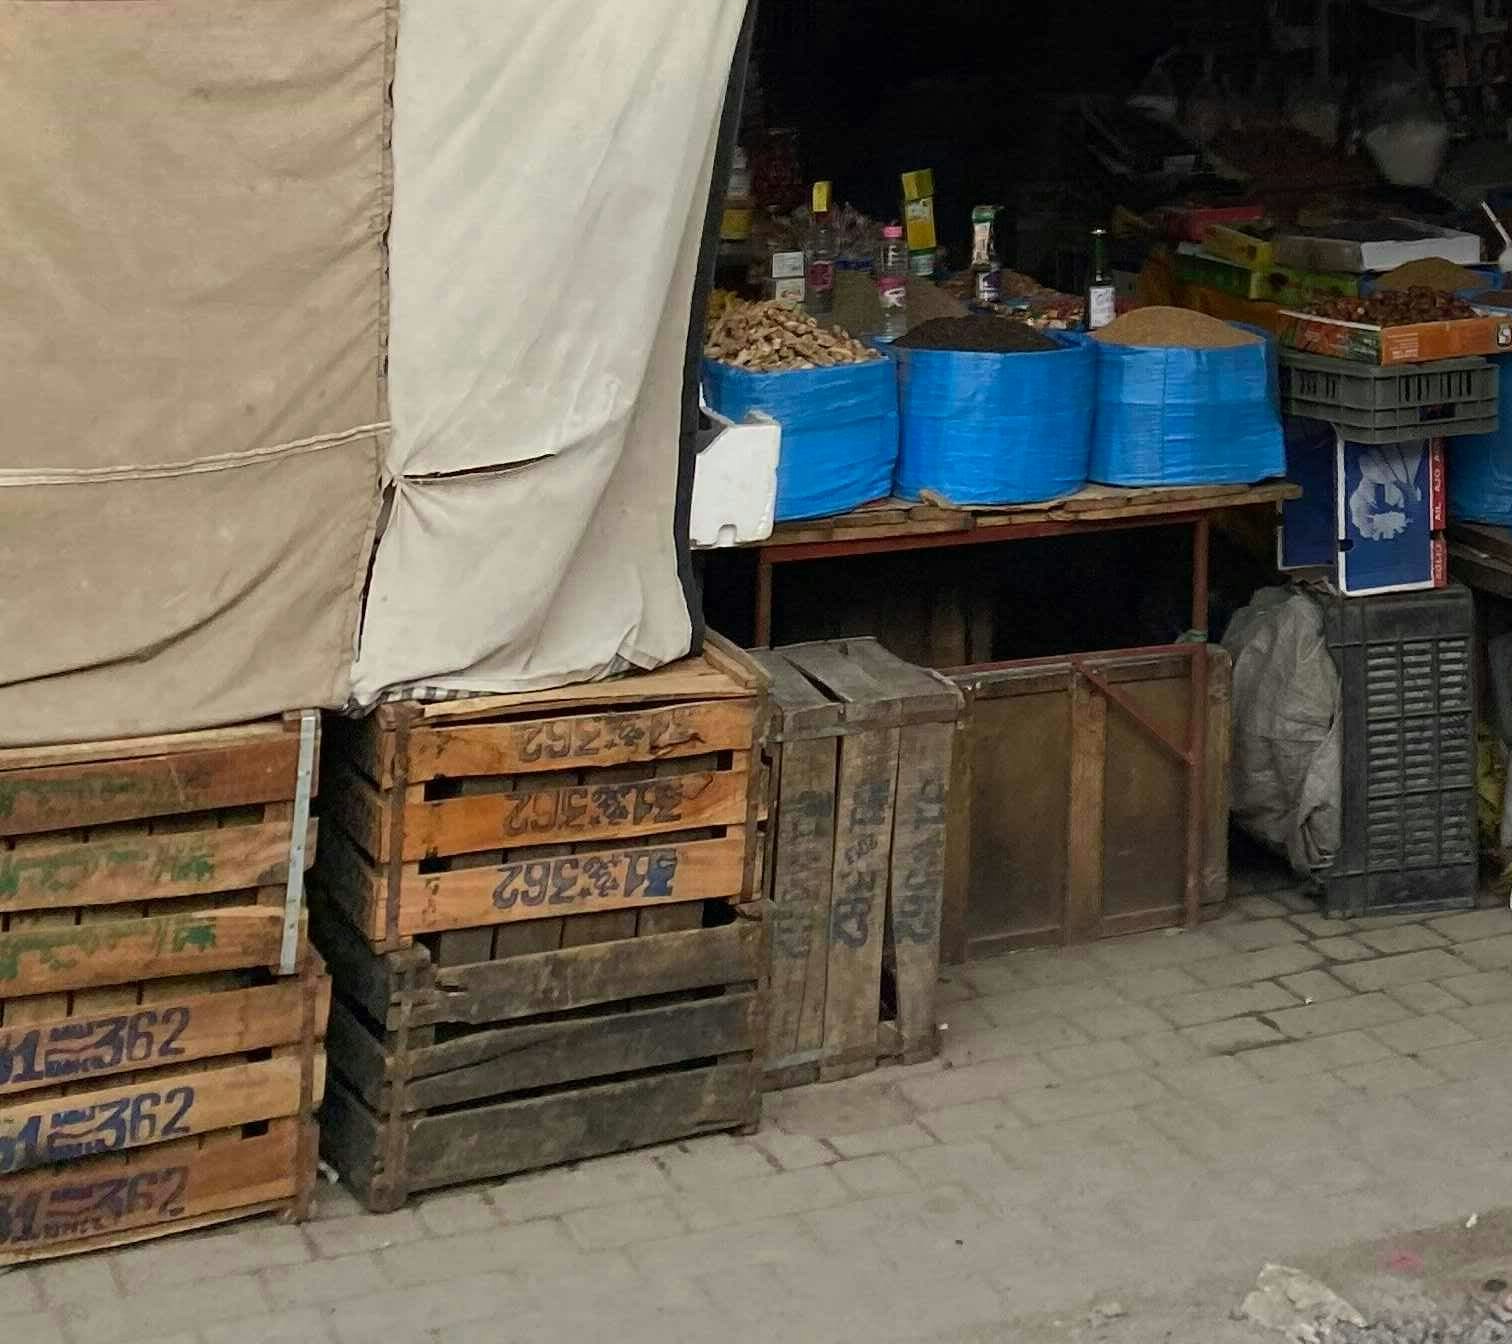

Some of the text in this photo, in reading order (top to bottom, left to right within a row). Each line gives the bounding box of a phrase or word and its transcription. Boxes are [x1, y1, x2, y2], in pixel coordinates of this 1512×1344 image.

[492, 857, 580, 910] 362
[93, 1006, 192, 1067] 362
[94, 1085, 195, 1156] 362
[94, 1166, 189, 1218] 362
